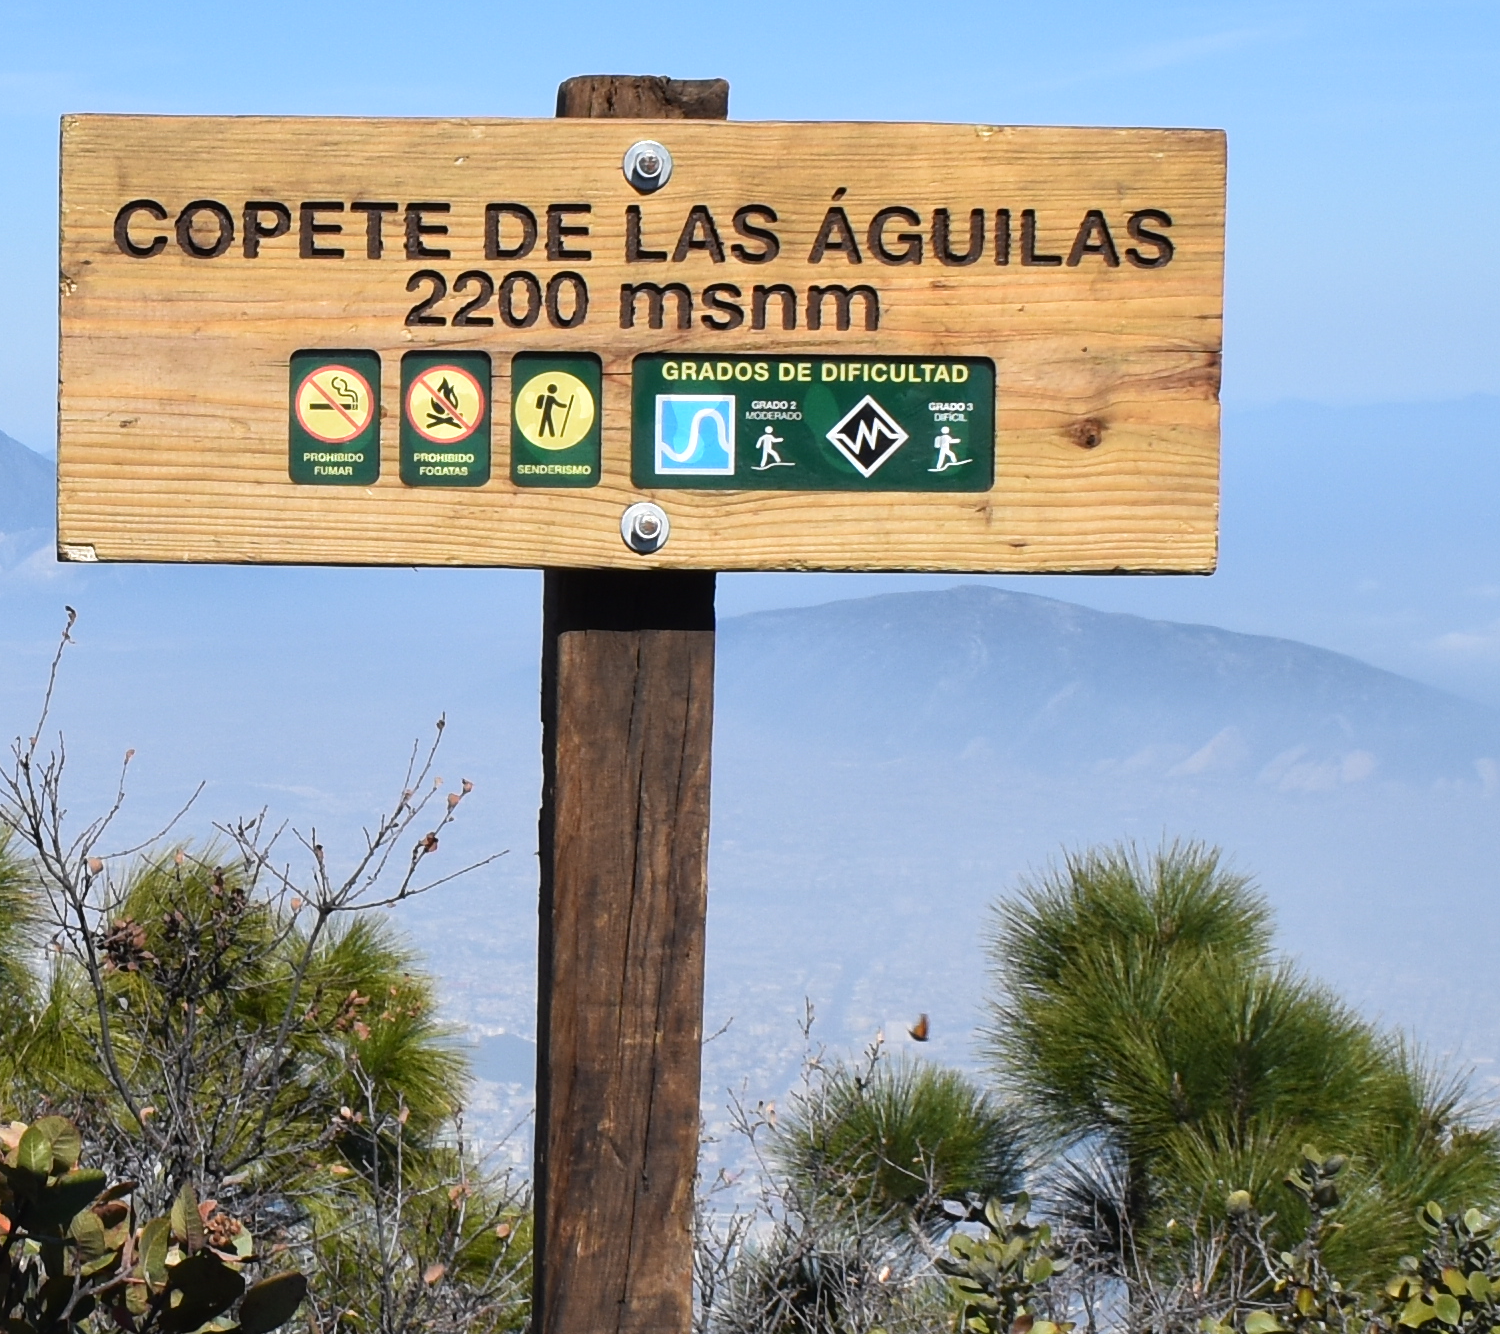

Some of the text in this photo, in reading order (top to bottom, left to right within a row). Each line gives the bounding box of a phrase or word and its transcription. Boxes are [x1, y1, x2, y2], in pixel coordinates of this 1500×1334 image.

[113, 187, 1176, 268] COPETE DE LAS ÁGUILAS
[405, 269, 880, 331] 2200 msnm
[661, 361, 969, 383] GRADOS DE DIFICULTAD
[751, 401, 797, 410] GRADO 2
[928, 402, 973, 411] GRADO 3
[745, 411, 802, 421] MODERADO
[303, 452, 364, 463] PROHIBIDO
[414, 453, 474, 463] PROHIBIDO
[314, 466, 353, 476] FUMAR
[419, 466, 468, 476] FOGATAS
[517, 465, 591, 475] SENDERISMO
